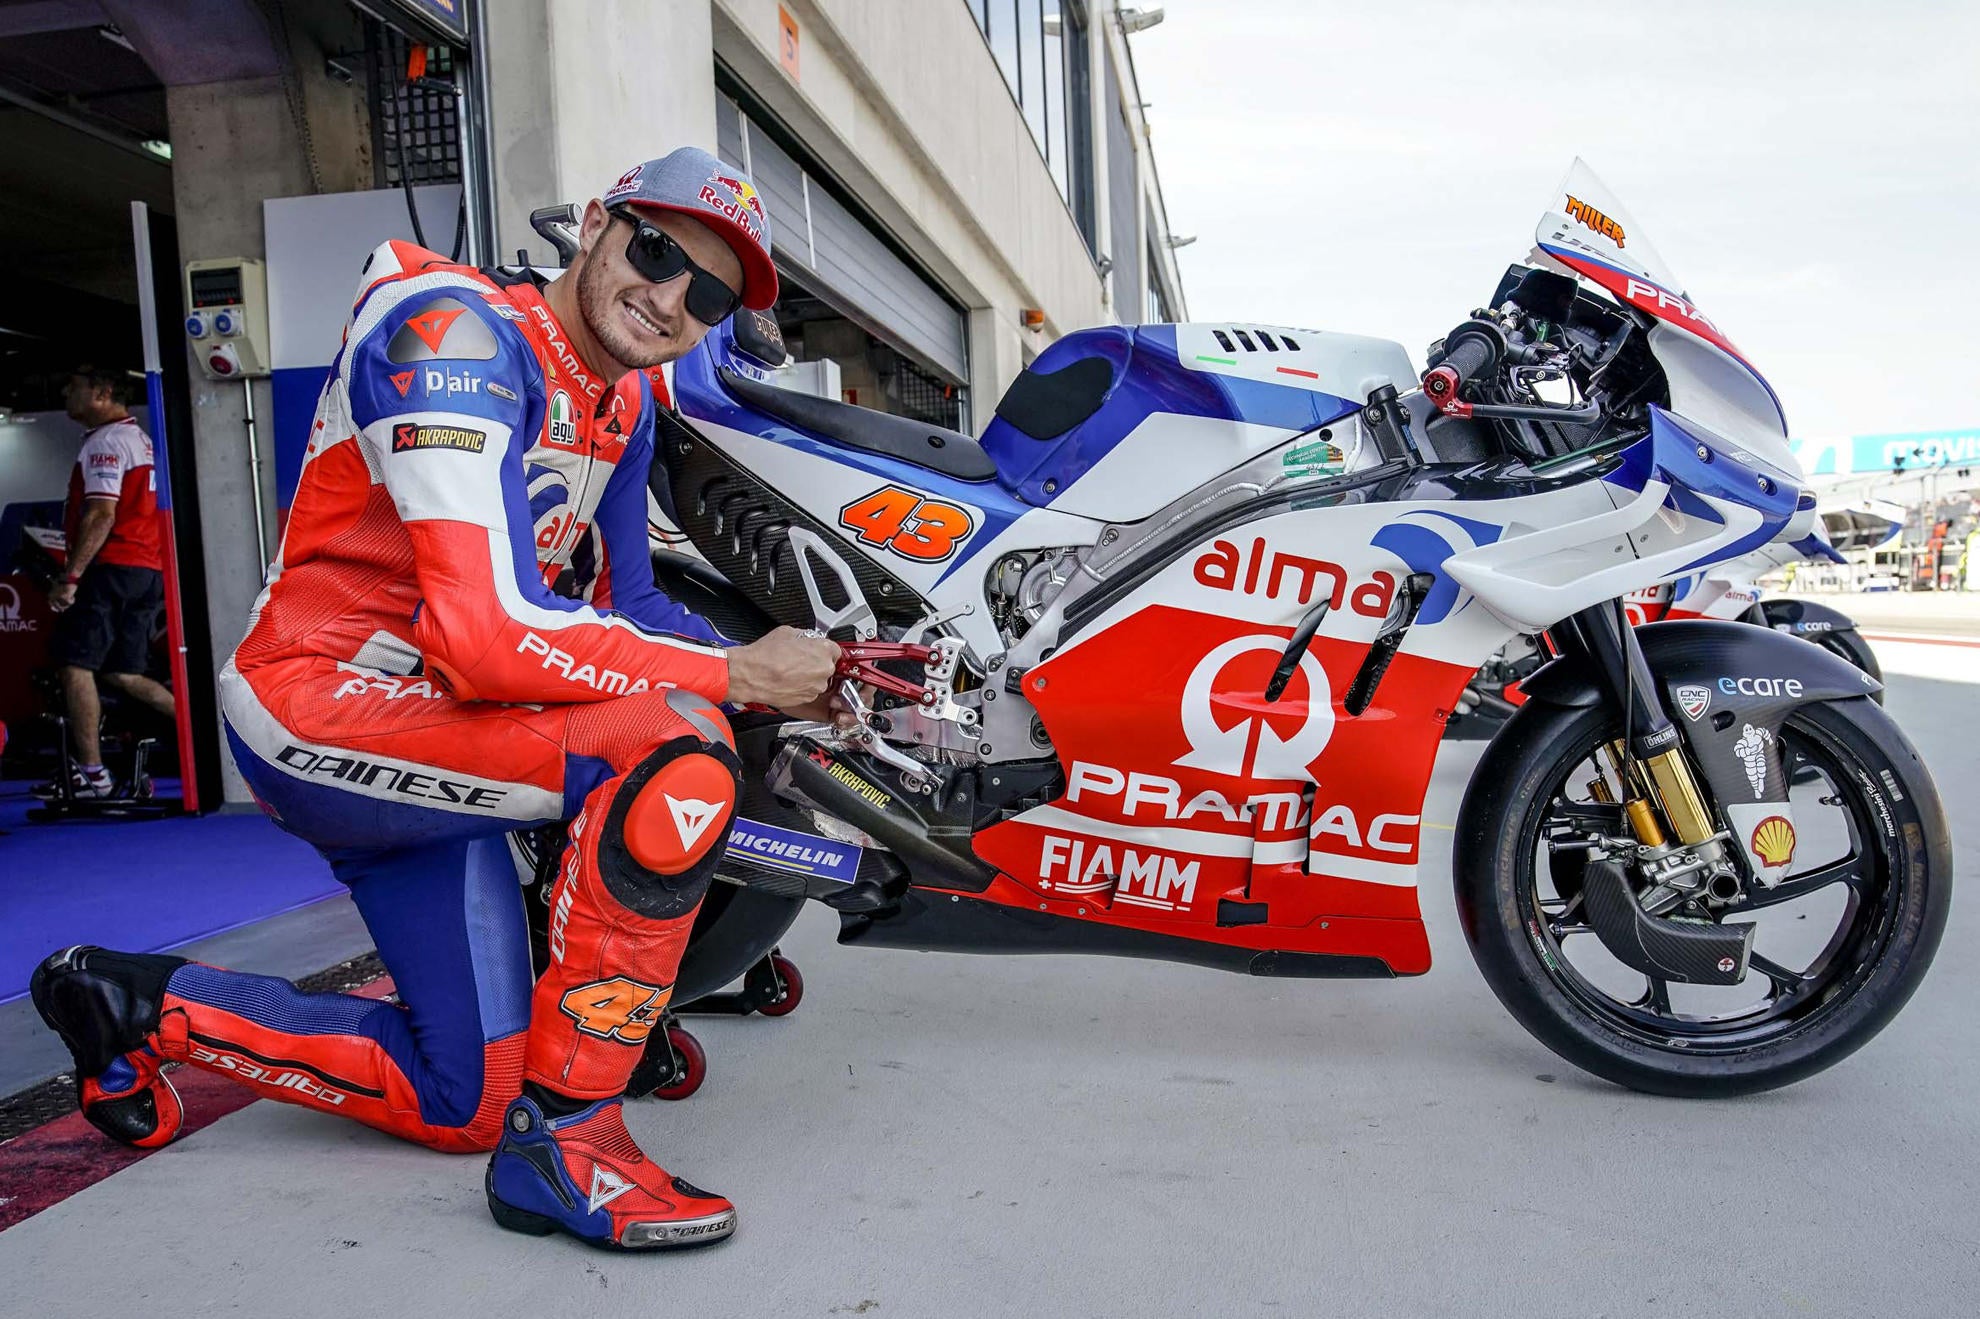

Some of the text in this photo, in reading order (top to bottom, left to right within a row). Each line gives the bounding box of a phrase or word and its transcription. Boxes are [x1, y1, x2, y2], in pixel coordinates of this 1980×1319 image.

[699, 185, 762, 242] Red Bull
[1565, 193, 1626, 249] MILLER
[1626, 278, 1719, 335] PRA
[530, 304, 601, 399] PRAMAC
[553, 421, 575, 443] agv
[1883, 437, 1980, 466] movi
[838, 484, 974, 564] 43
[1193, 537, 1396, 619] alma
[1797, 621, 1832, 632] ecare
[333, 678, 443, 700] PRA
[1717, 677, 1803, 698] ecare
[275, 745, 508, 810] DAINESE
[1066, 760, 1420, 853] PRAMAC
[1871, 792, 1896, 837] marchesini
[727, 829, 844, 868] MICHELIN
[1039, 835, 1201, 904] FIAMM
[189, 1047, 347, 1106] DAINESE
[679, 1219, 729, 1237] DAINESE
